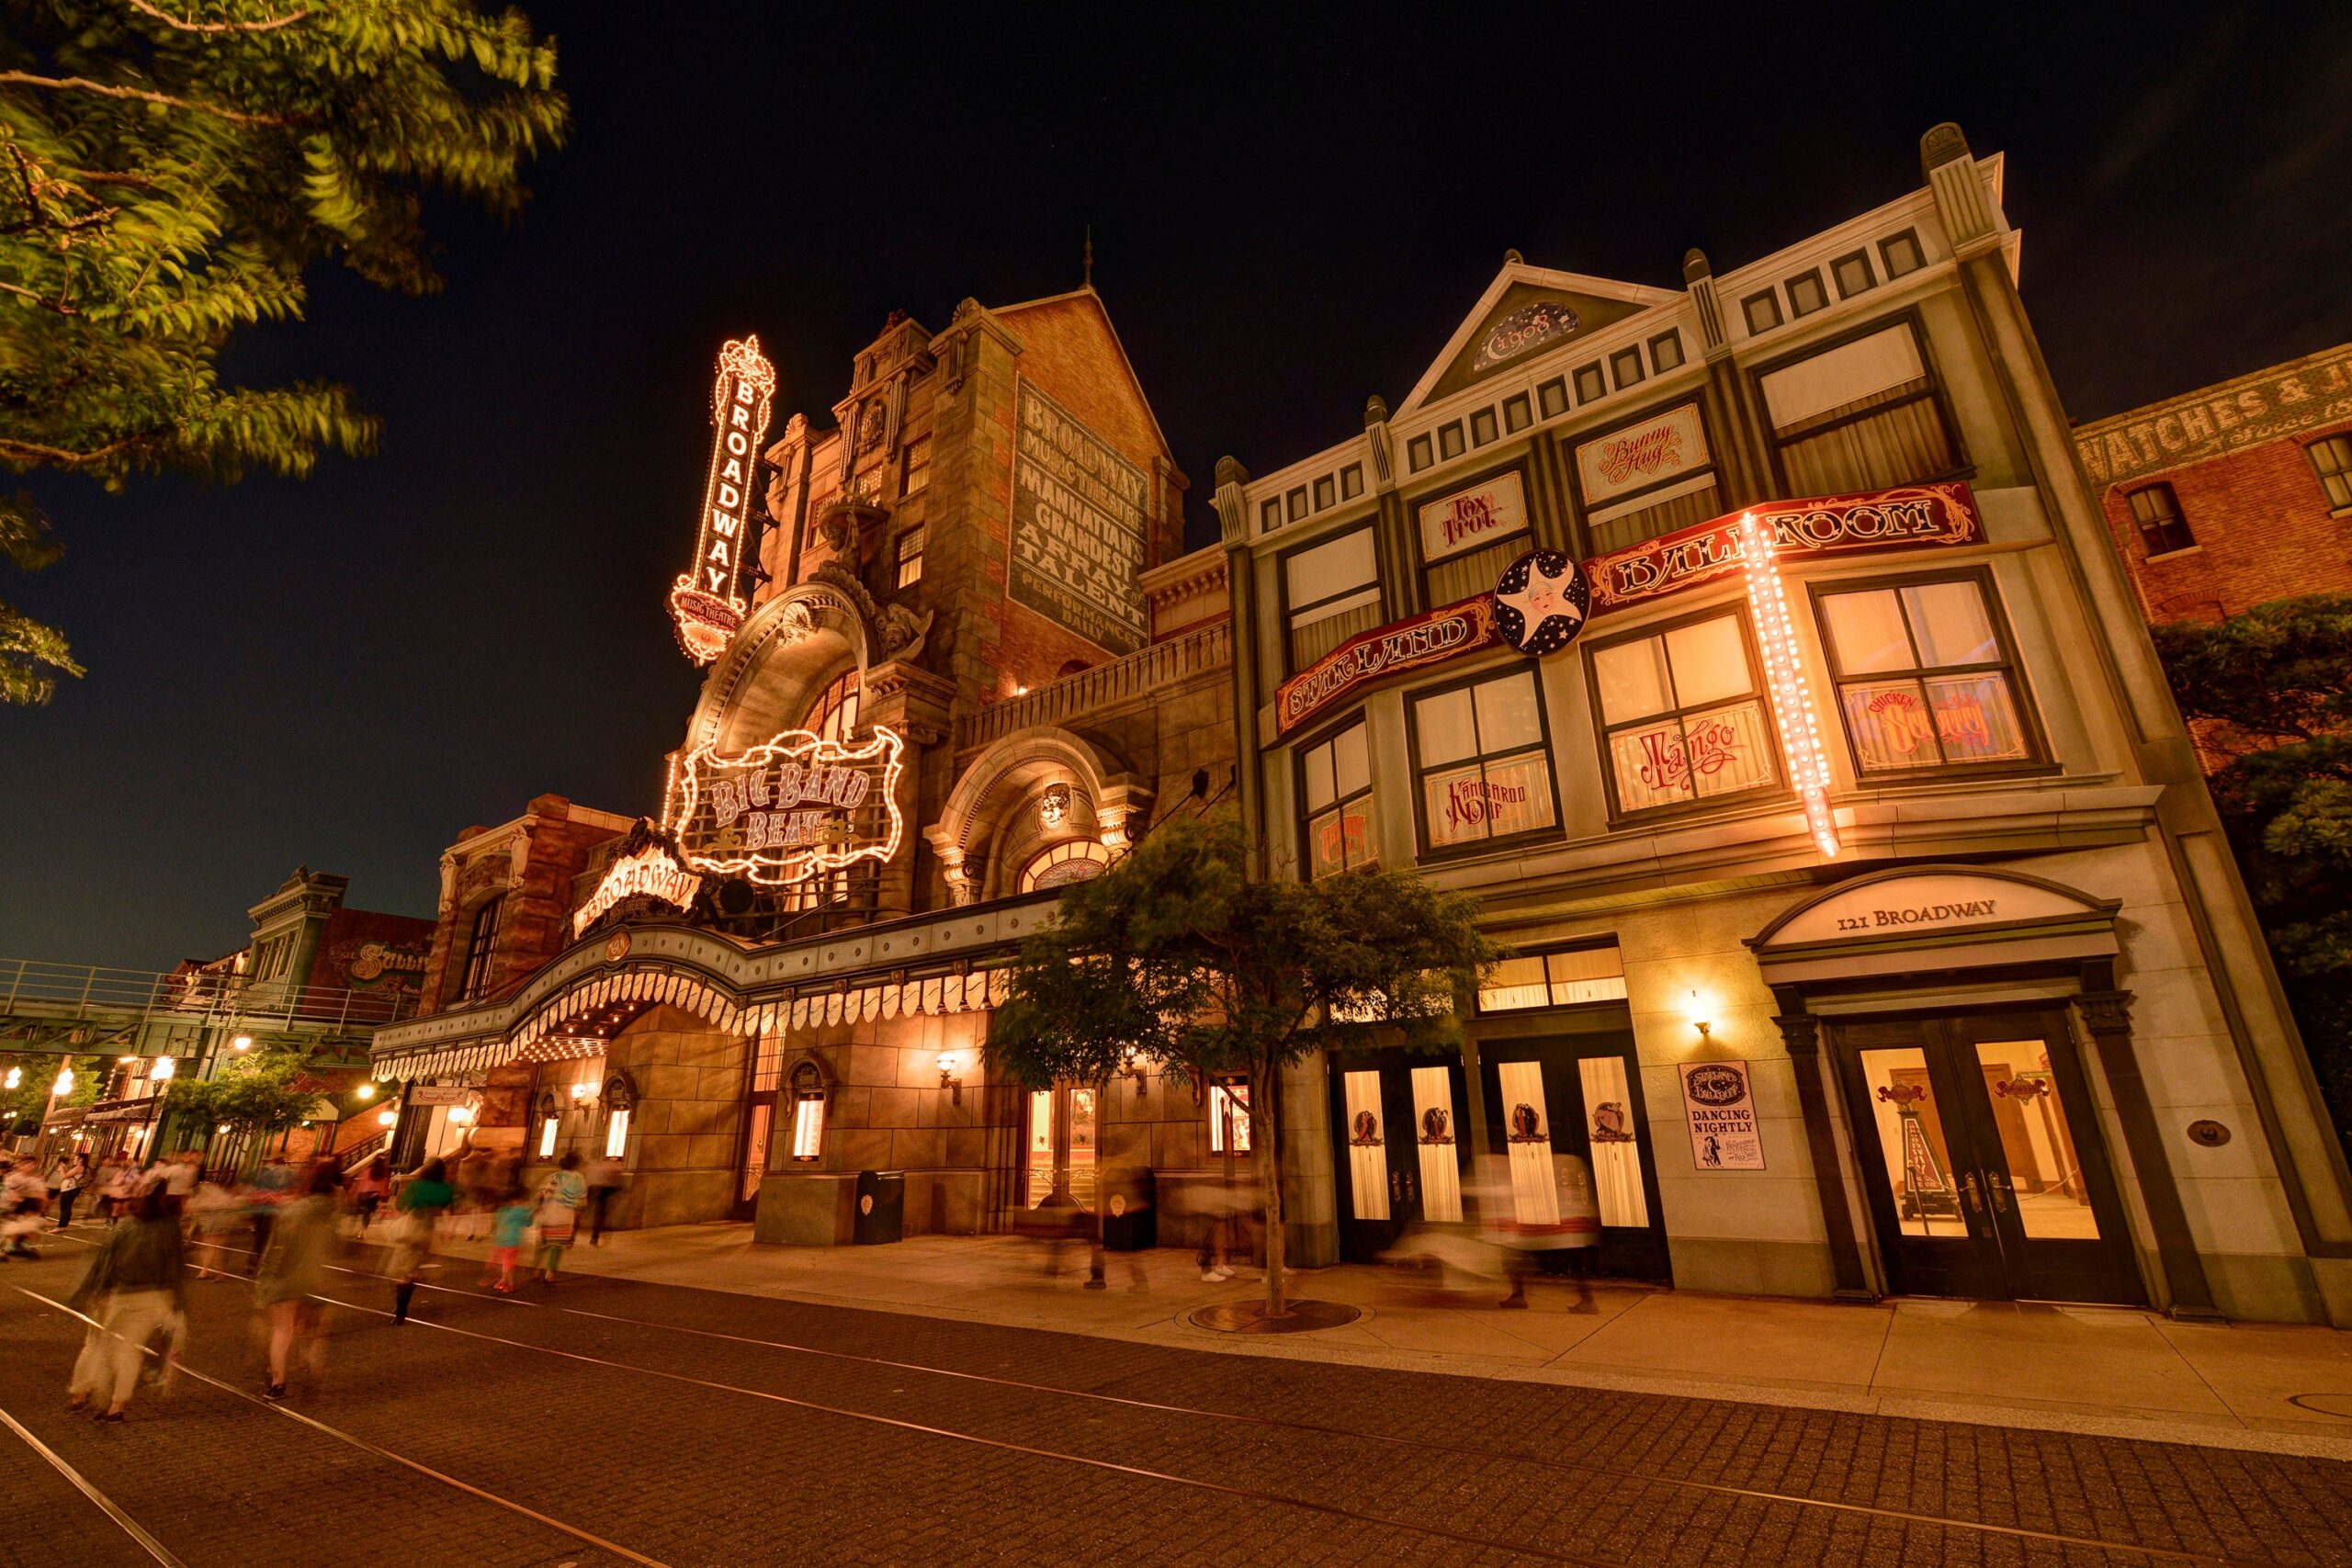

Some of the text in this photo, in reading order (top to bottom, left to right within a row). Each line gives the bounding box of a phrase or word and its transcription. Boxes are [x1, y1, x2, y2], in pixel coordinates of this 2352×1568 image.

[1498, 314, 1550, 352] 1908
[2278, 378, 2314, 404] &
[1023, 392, 1144, 505] BROADWAY
[1604, 423, 1675, 468] Bunny
[705, 378, 755, 594] BROADWAY
[1023, 428, 1145, 534] MUSIC THEATRE
[1020, 463, 1144, 566] MANHATTAN'S
[1442, 506, 1503, 547] Trot
[1018, 521, 1132, 600] ARRAY
[1035, 502, 1132, 583] GRANDEST
[1016, 536, 1145, 626] TALENT
[680, 596, 737, 628] MUSIC THEATRE
[1022, 571, 1141, 650] PERFORMANCES
[1062, 608, 1102, 641] DAILY
[1869, 693, 1918, 716] CHICKEN
[1641, 720, 1736, 790] Tango
[710, 763, 870, 828] BIG BAND
[744, 811, 825, 852] BEAT
[585, 863, 693, 923] BROADWAY
[1838, 899, 1996, 931] 121 BROADWAY
[1691, 1110, 1751, 1121] DANCING
[1694, 1122, 1753, 1133] NIGHTLY
